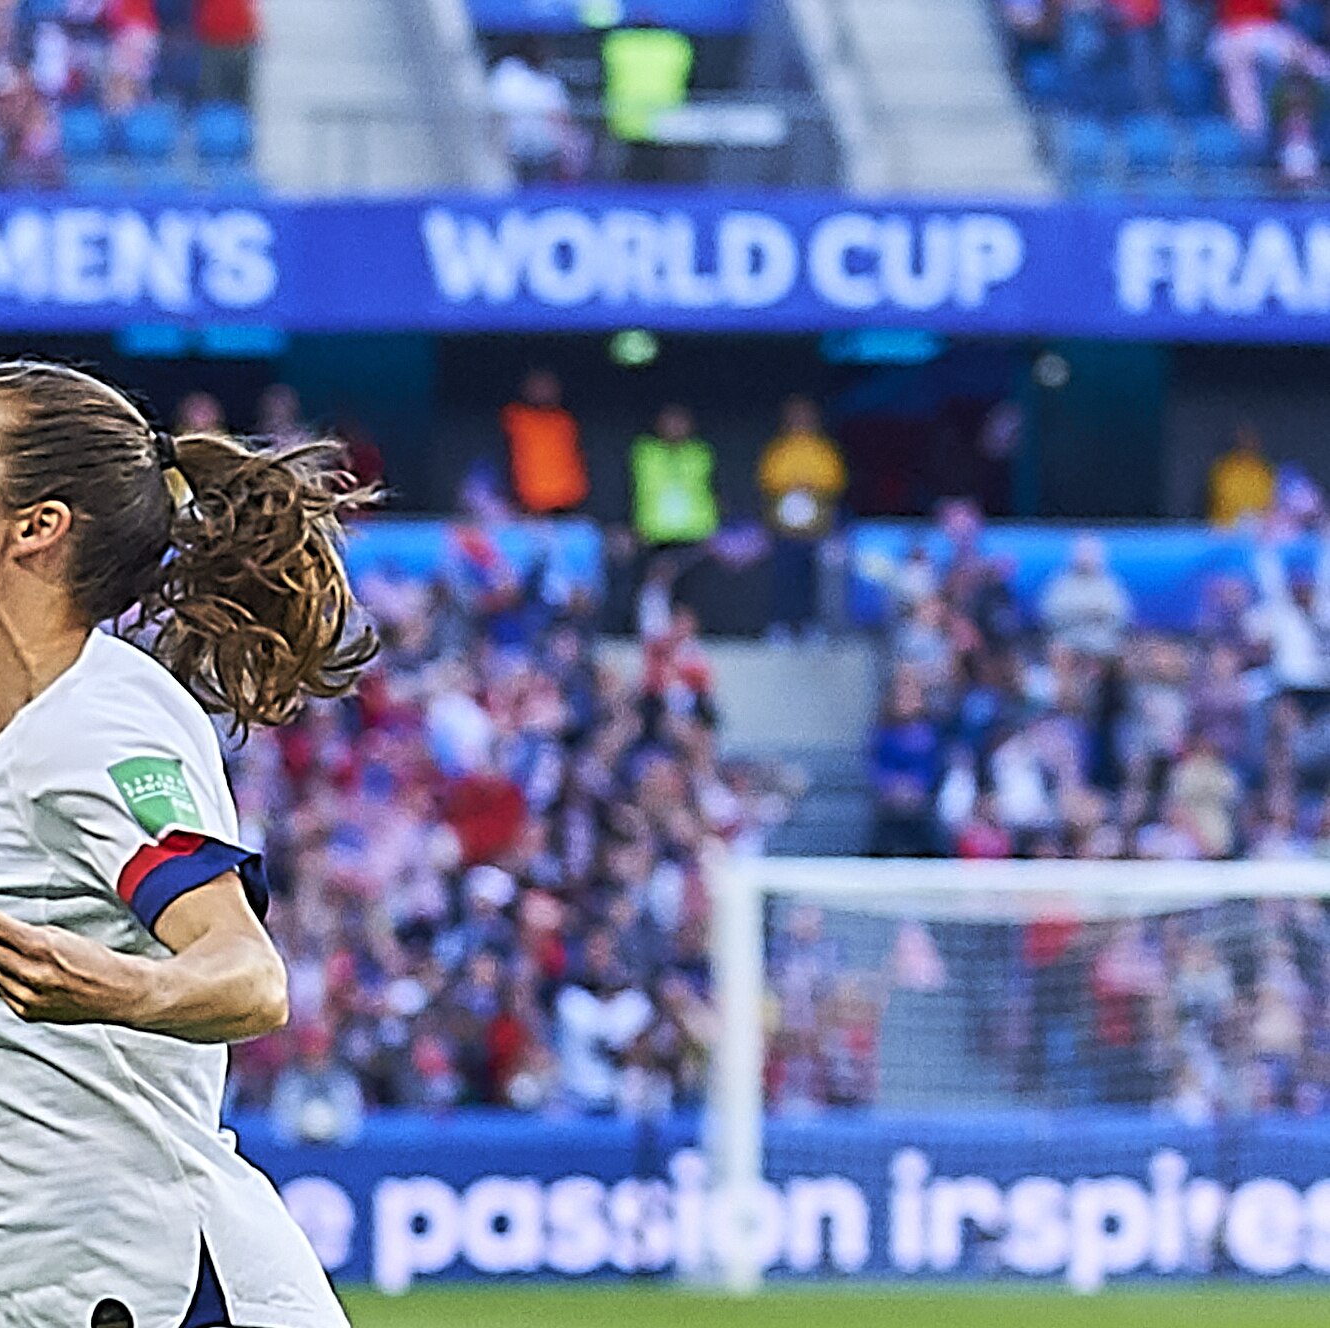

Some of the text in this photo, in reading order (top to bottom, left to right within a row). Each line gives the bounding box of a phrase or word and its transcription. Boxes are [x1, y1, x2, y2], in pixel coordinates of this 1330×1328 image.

[421, 208, 799, 308] WORLD
[808, 211, 1025, 311] CUP
[371, 1148, 868, 1296] passion
